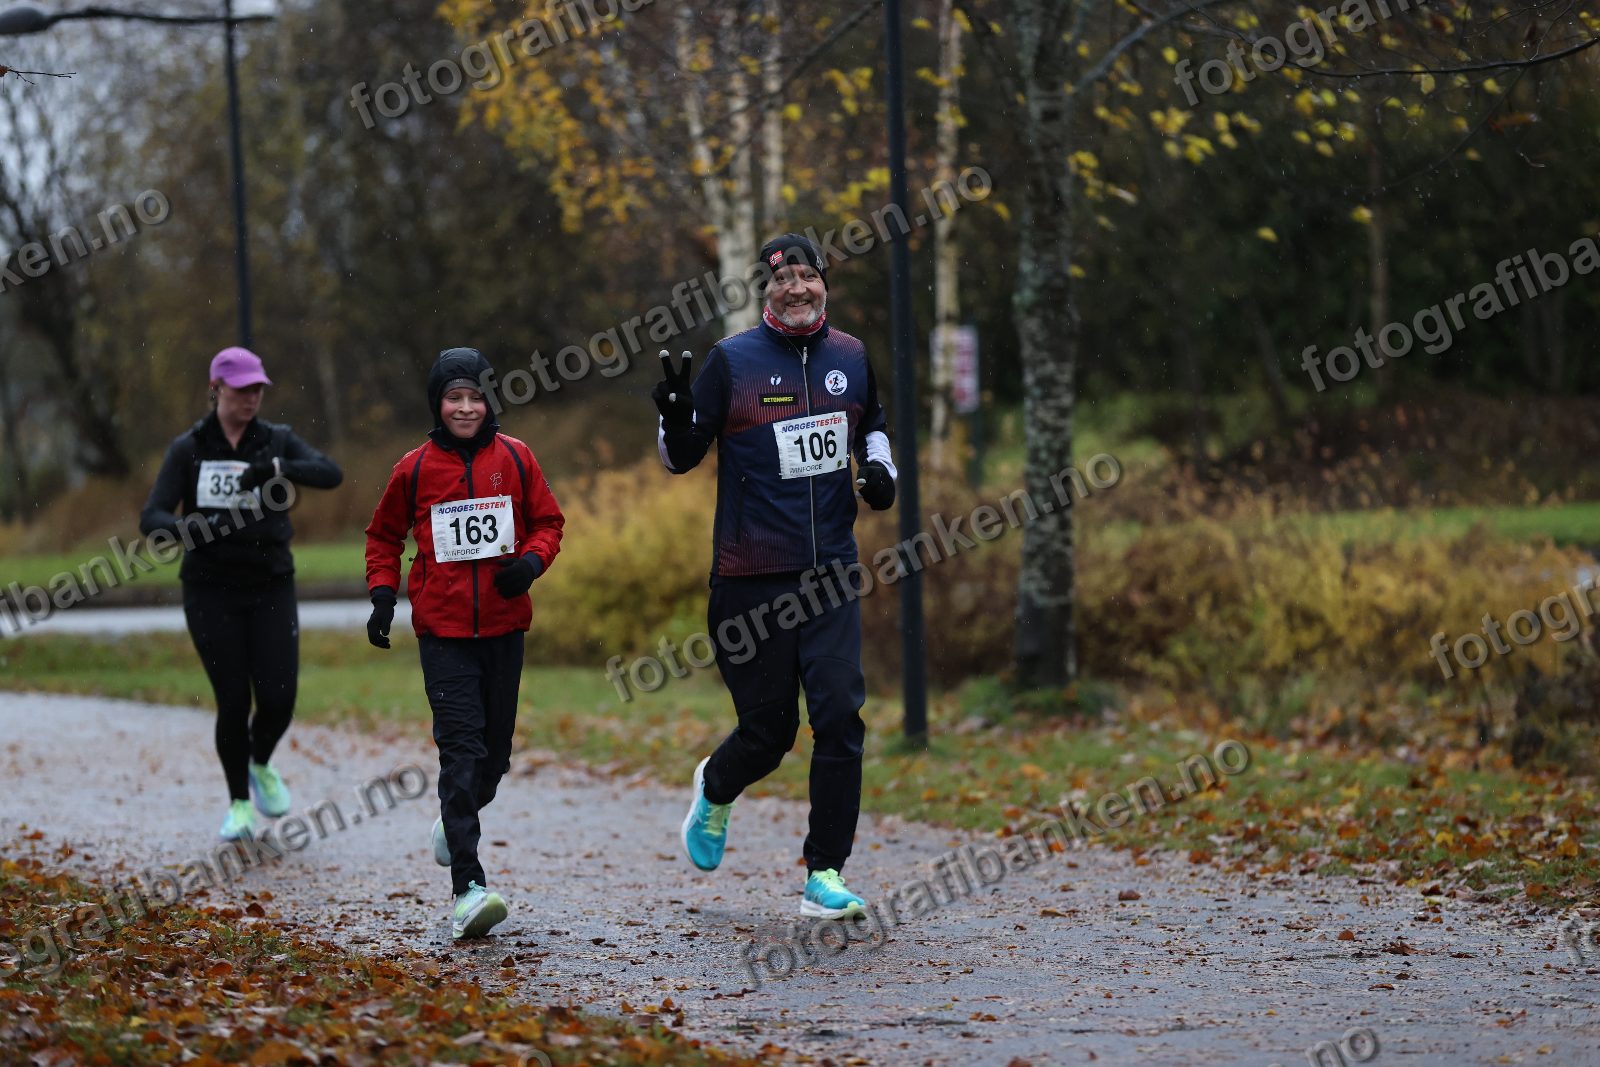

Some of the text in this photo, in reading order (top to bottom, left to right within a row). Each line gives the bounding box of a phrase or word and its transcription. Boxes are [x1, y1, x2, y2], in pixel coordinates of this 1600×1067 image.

[794, 430, 837, 463] 106
[438, 500, 507, 515] NORGESTESTEN
[449, 514, 499, 546] 163
[443, 547, 481, 557] WINFORCE
